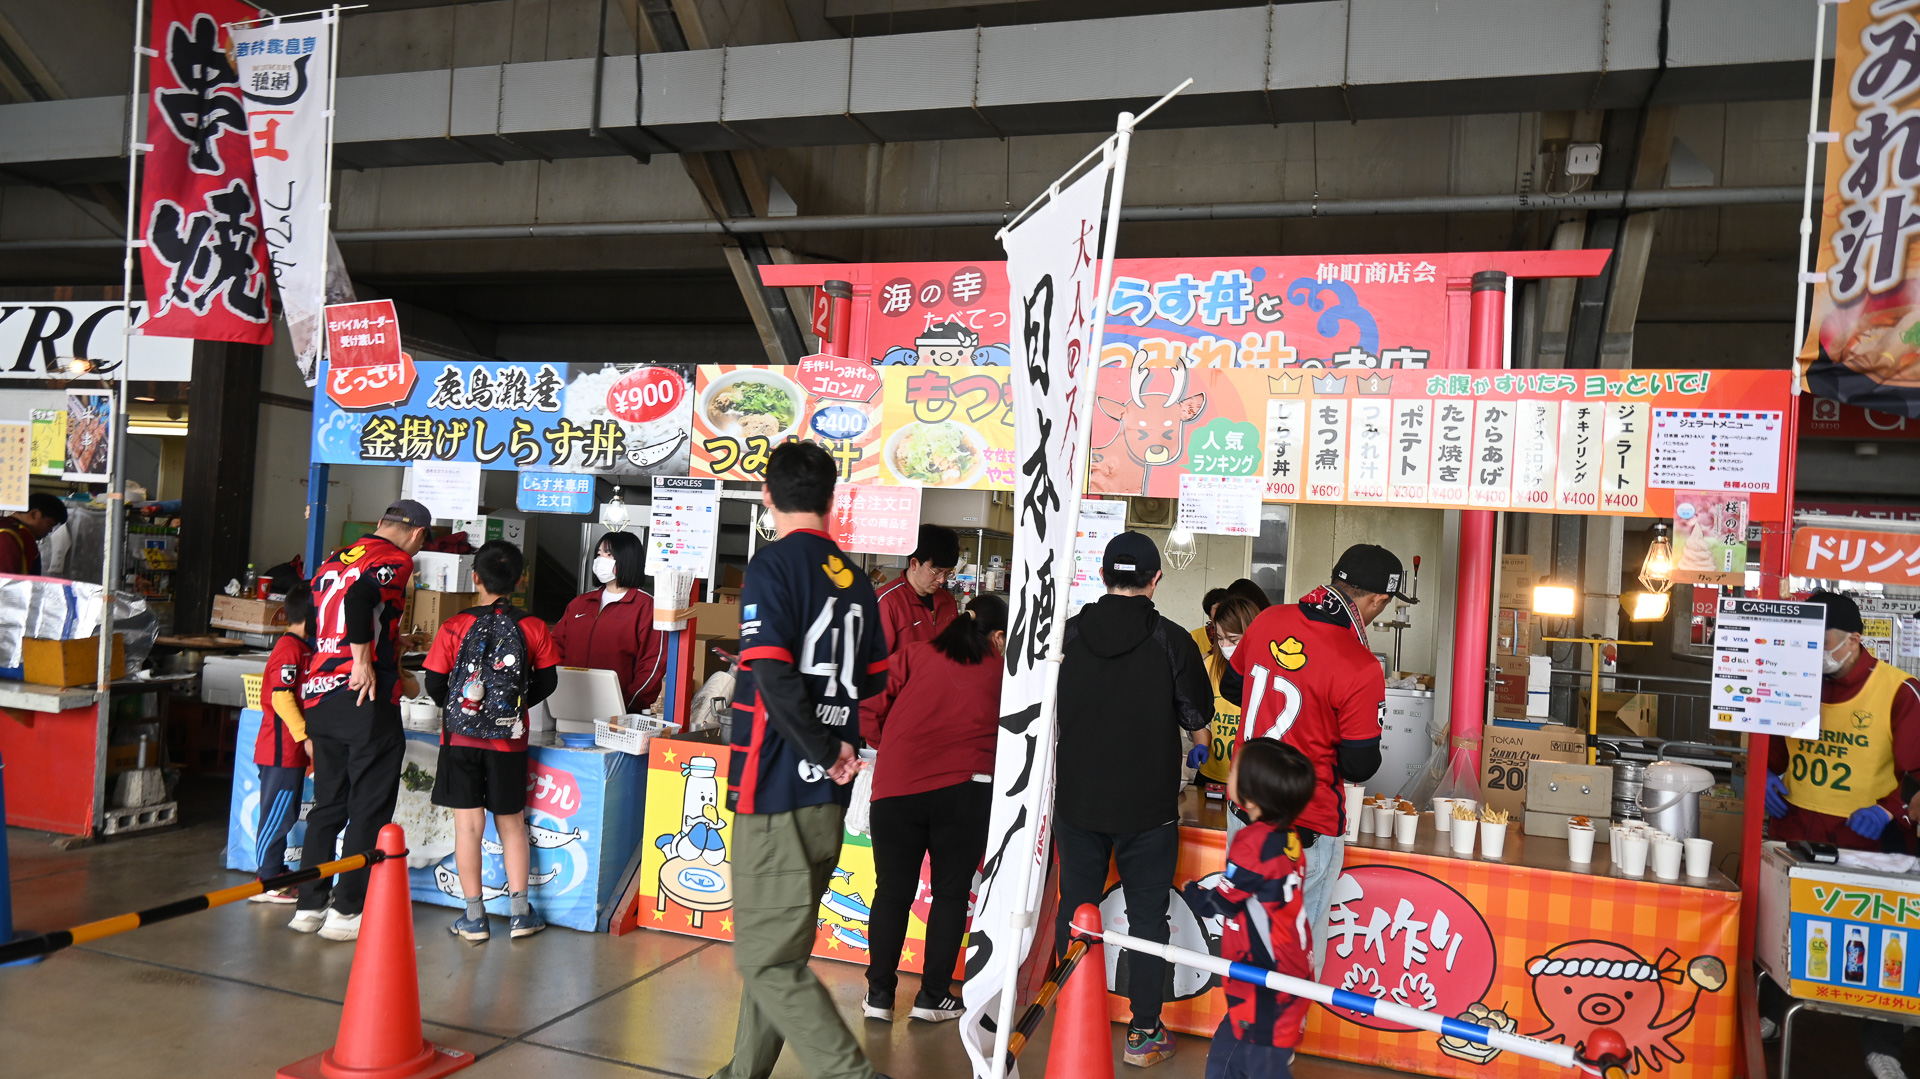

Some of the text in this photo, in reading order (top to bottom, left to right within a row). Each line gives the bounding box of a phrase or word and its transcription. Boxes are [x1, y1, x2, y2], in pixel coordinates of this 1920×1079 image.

[1830, 0, 1920, 294] みれ汁
[148, 13, 270, 323] 串焼
[1316, 261, 1437, 284] 仲町商店会
[882, 271, 983, 313] 海の幸
[1091, 270, 1283, 326] らす丼と
[329, 315, 394, 332] モバイルオーダー
[815, 296, 829, 334] 2
[0, 305, 142, 374] RC
[340, 333, 386, 348] 受け渡し口
[1060, 219, 1094, 491] 大人のスイ
[802, 359, 876, 382] 手作りつみれが
[428, 366, 563, 411] 鹿島灘産
[812, 376, 864, 398] ゴロン!!
[1282, 379, 1288, 391] 1
[1325, 379, 1332, 391] 2
[1371, 379, 1378, 391] 3
[1426, 371, 1711, 397] お腹が すいたら ヨッといで!
[612, 379, 675, 414] ¥900
[907, 370, 1014, 427] もつ
[815, 413, 863, 432] ¥400
[1680, 419, 1753, 430] ジェラートメニュー
[1811, 421, 1840, 430] ひまわり
[361, 416, 625, 467] 釜揚げしらす丼
[1202, 430, 1244, 451] 人気
[1272, 404, 1292, 477] しらす丼
[1315, 405, 1340, 471] もつ煮
[1359, 405, 1382, 480] つみれ汁
[1399, 404, 1424, 476] ポテト
[1437, 404, 1465, 482] たこ焼き
[1480, 406, 1508, 486] からあげ
[1573, 406, 1591, 484] チキンリング
[1616, 404, 1635, 490] ジェラート
[703, 436, 863, 481] つみ汁
[1193, 454, 1254, 474] ランキング
[522, 477, 589, 492] しらす丼専用
[667, 478, 703, 487] CASHLESS
[1266, 482, 1295, 495] ¥900
[1311, 485, 1341, 497] ¥600
[1353, 486, 1383, 498] ¥400
[1393, 486, 1424, 499] ¥300
[1723, 481, 1770, 490] 各種400円
[536, 494, 572, 508] 注文口
[838, 494, 912, 512] 総合注文口
[1431, 488, 1462, 500] ¥400
[1475, 491, 1506, 503] ¥400
[1517, 490, 1548, 503] ¥400
[1562, 491, 1595, 505] ¥400
[1605, 493, 1638, 507] ¥400
[1079, 503, 1108, 512] SHLESS
[838, 515, 908, 530] すべての商品を
[1724, 500, 1740, 546] 桜の花
[838, 532, 906, 548] ご注文できます
[1742, 602, 1800, 615] CASHLESS
[1882, 602, 1920, 612] カテゴリ
[1244, 663, 1302, 740] 12
[1214, 712, 1240, 724] ATE
[1217, 725, 1237, 737] STA
[1491, 736, 1524, 746] TOKAN
[1817, 729, 1870, 748] ERING
[1214, 738, 1235, 761] 00
[1798, 740, 1848, 758] STAFF
[1487, 765, 1528, 791] 20
[1792, 753, 1851, 791] 002
[1327, 873, 1464, 971] 手作り
[1816, 986, 1920, 1011] ※キャップは外し
